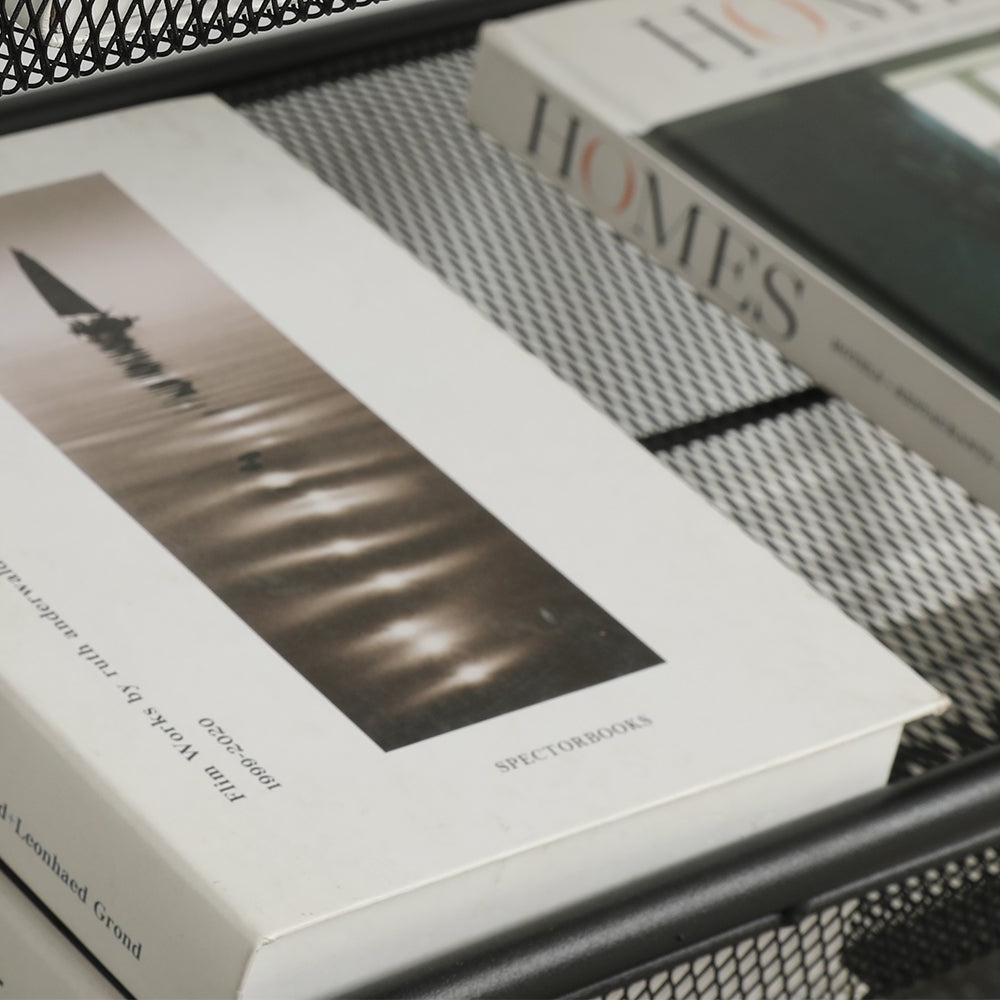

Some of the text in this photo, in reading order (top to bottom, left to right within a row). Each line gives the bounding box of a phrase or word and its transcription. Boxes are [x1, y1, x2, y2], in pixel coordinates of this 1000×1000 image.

[527, 93, 806, 342] HOMES
[78, 644, 118, 677] ruth
[117, 684, 143, 704] by
[143, 707, 200, 772] Works
[198, 717, 282, 790] 1999-2020
[494, 714, 654, 774] SPECTORBOOKS
[93, 900, 143, 961] Grond
